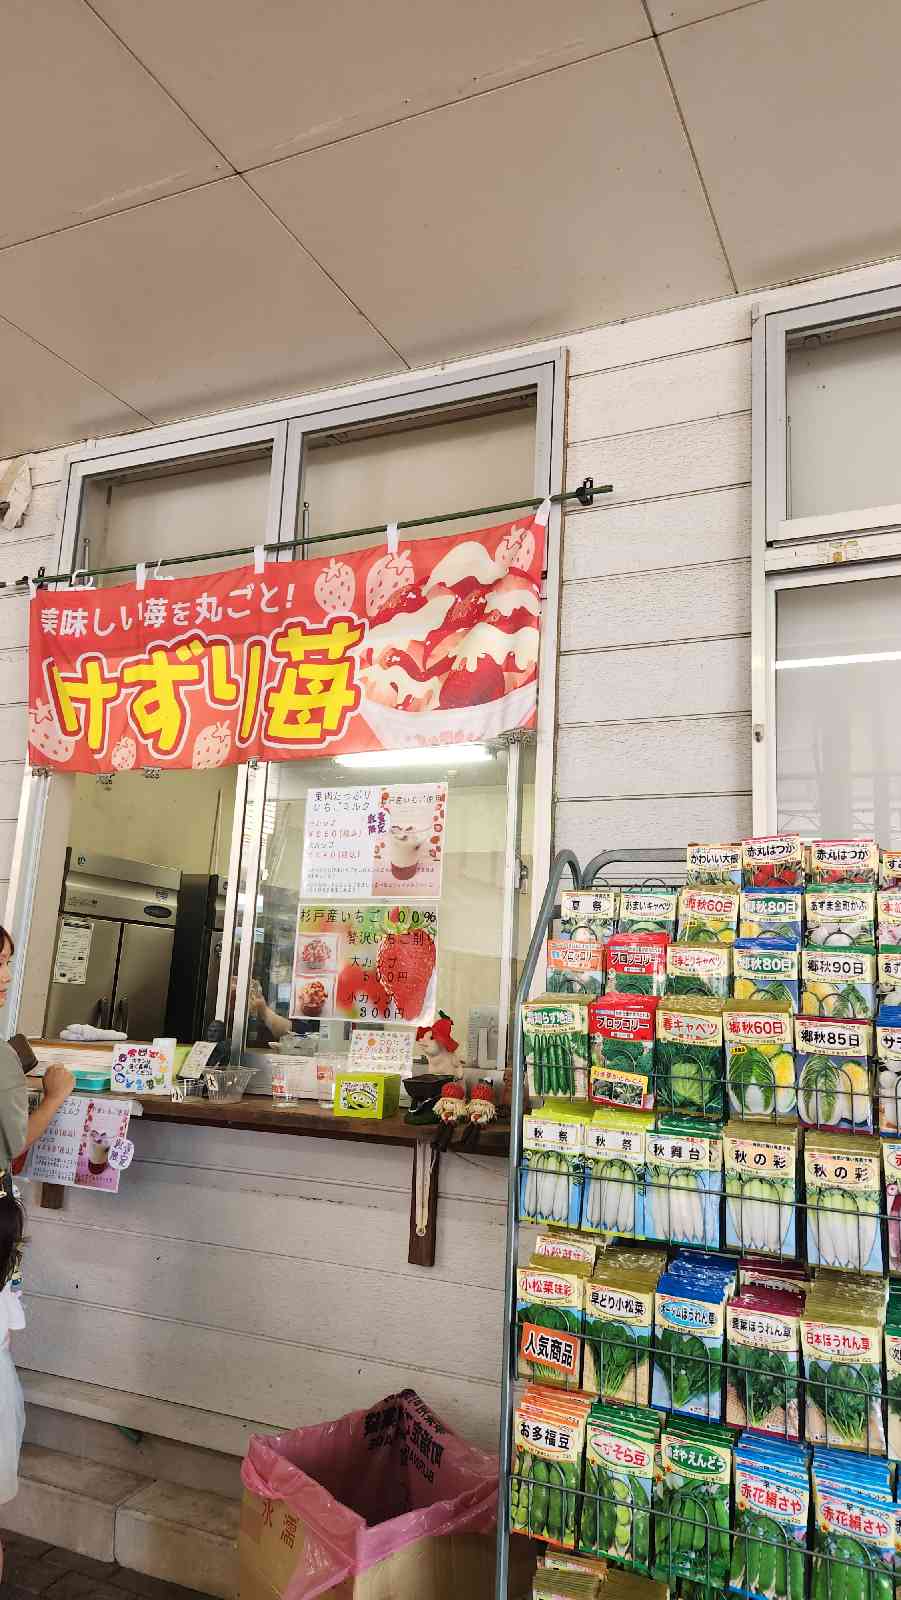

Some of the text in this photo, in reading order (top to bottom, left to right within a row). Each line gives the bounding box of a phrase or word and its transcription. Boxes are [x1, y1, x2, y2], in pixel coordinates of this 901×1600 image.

[40, 583, 295, 637] 美味しい苺を丸ごと!
[48, 620, 366, 756] けずり苺
[690, 853, 739, 865] かわいい大根
[746, 844, 796, 859] 赤丸はつか
[816, 849, 869, 862] 赤丸はつか
[610, 952, 658, 966] ブロッコリー
[596, 1015, 650, 1031] ブロッコリー
[800, 1029, 860, 1047] 郷秋85日
[734, 1149, 786, 1169] 秋の彩
[814, 1163, 868, 1182] 秋の彩
[591, 1292, 644, 1316] 早どり小松菜
[525, 1331, 574, 1368] 人気商品
[806, 1332, 871, 1352] 日本ほうれん草
[520, 1421, 570, 1450] お多福豆
[740, 1483, 802, 1517] 赤花絹さや
[822, 1505, 889, 1538] 赤花絹さや
